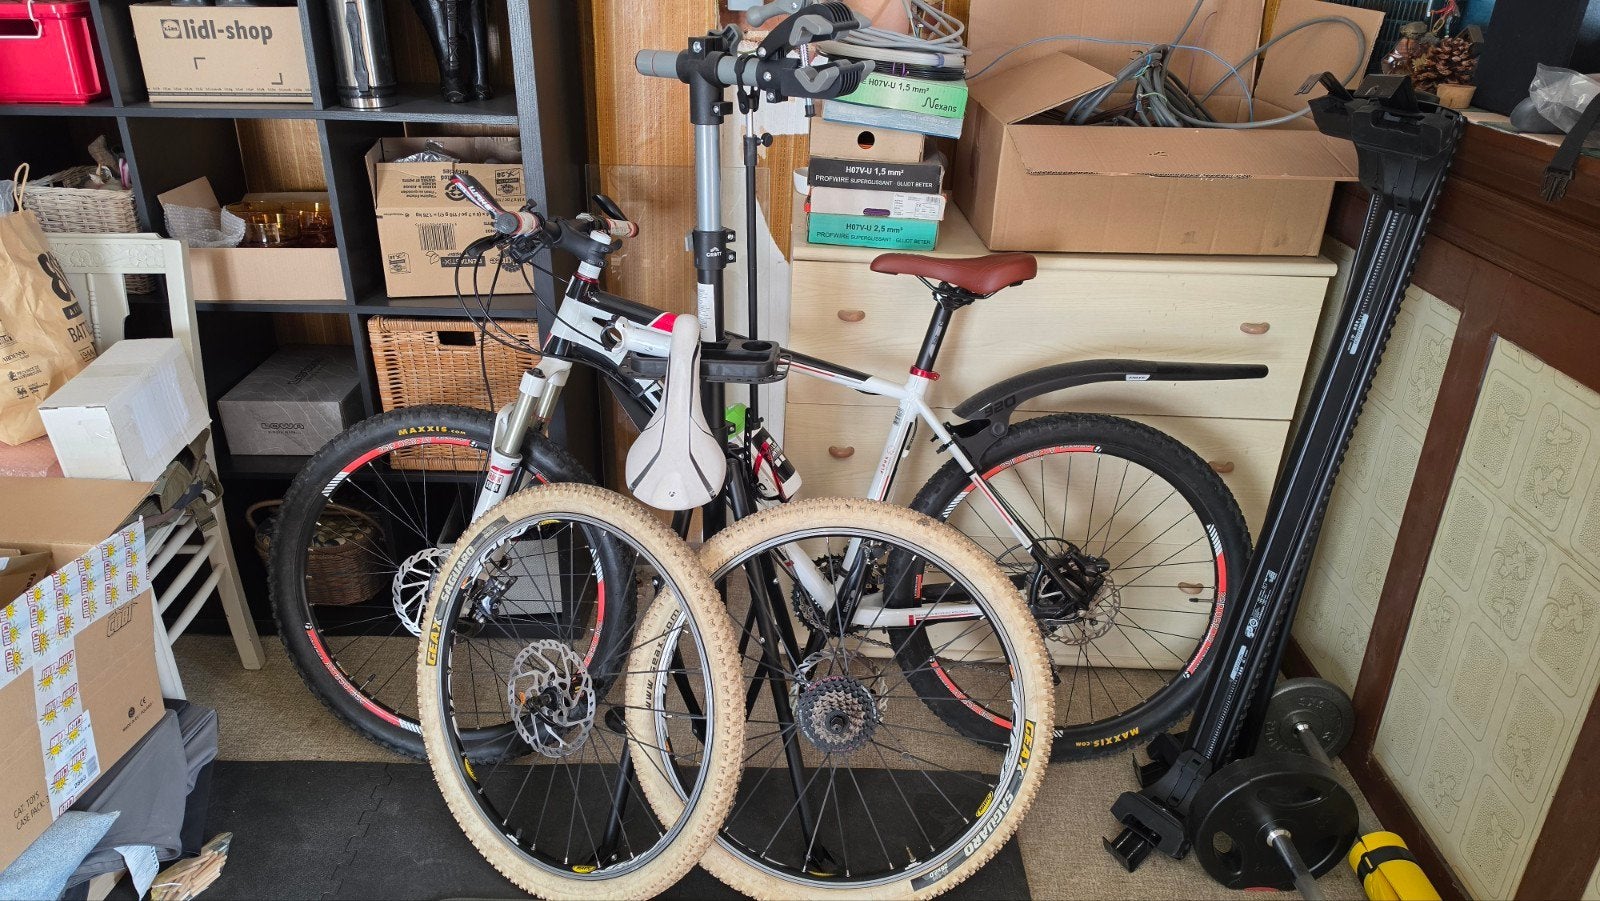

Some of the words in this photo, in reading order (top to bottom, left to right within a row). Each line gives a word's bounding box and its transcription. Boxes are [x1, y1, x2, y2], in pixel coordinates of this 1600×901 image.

[183, 19, 273, 45] lidl-shop
[868, 78, 896, 89] H07V-U
[899, 83, 911, 92] 1,5
[922, 97, 958, 113] Nexans
[845, 166, 873, 175] H07V-U
[874, 167, 887, 176] 1,5
[846, 223, 872, 232] H07V-U
[874, 224, 886, 233] 2,5
[261, 422, 305, 430] LOWA
[440, 545, 477, 602] SAGUARO
[426, 618, 443, 667] GEAX
[1016, 720, 1036, 779] GEAX
[964, 793, 1014, 857] SAGUARO
